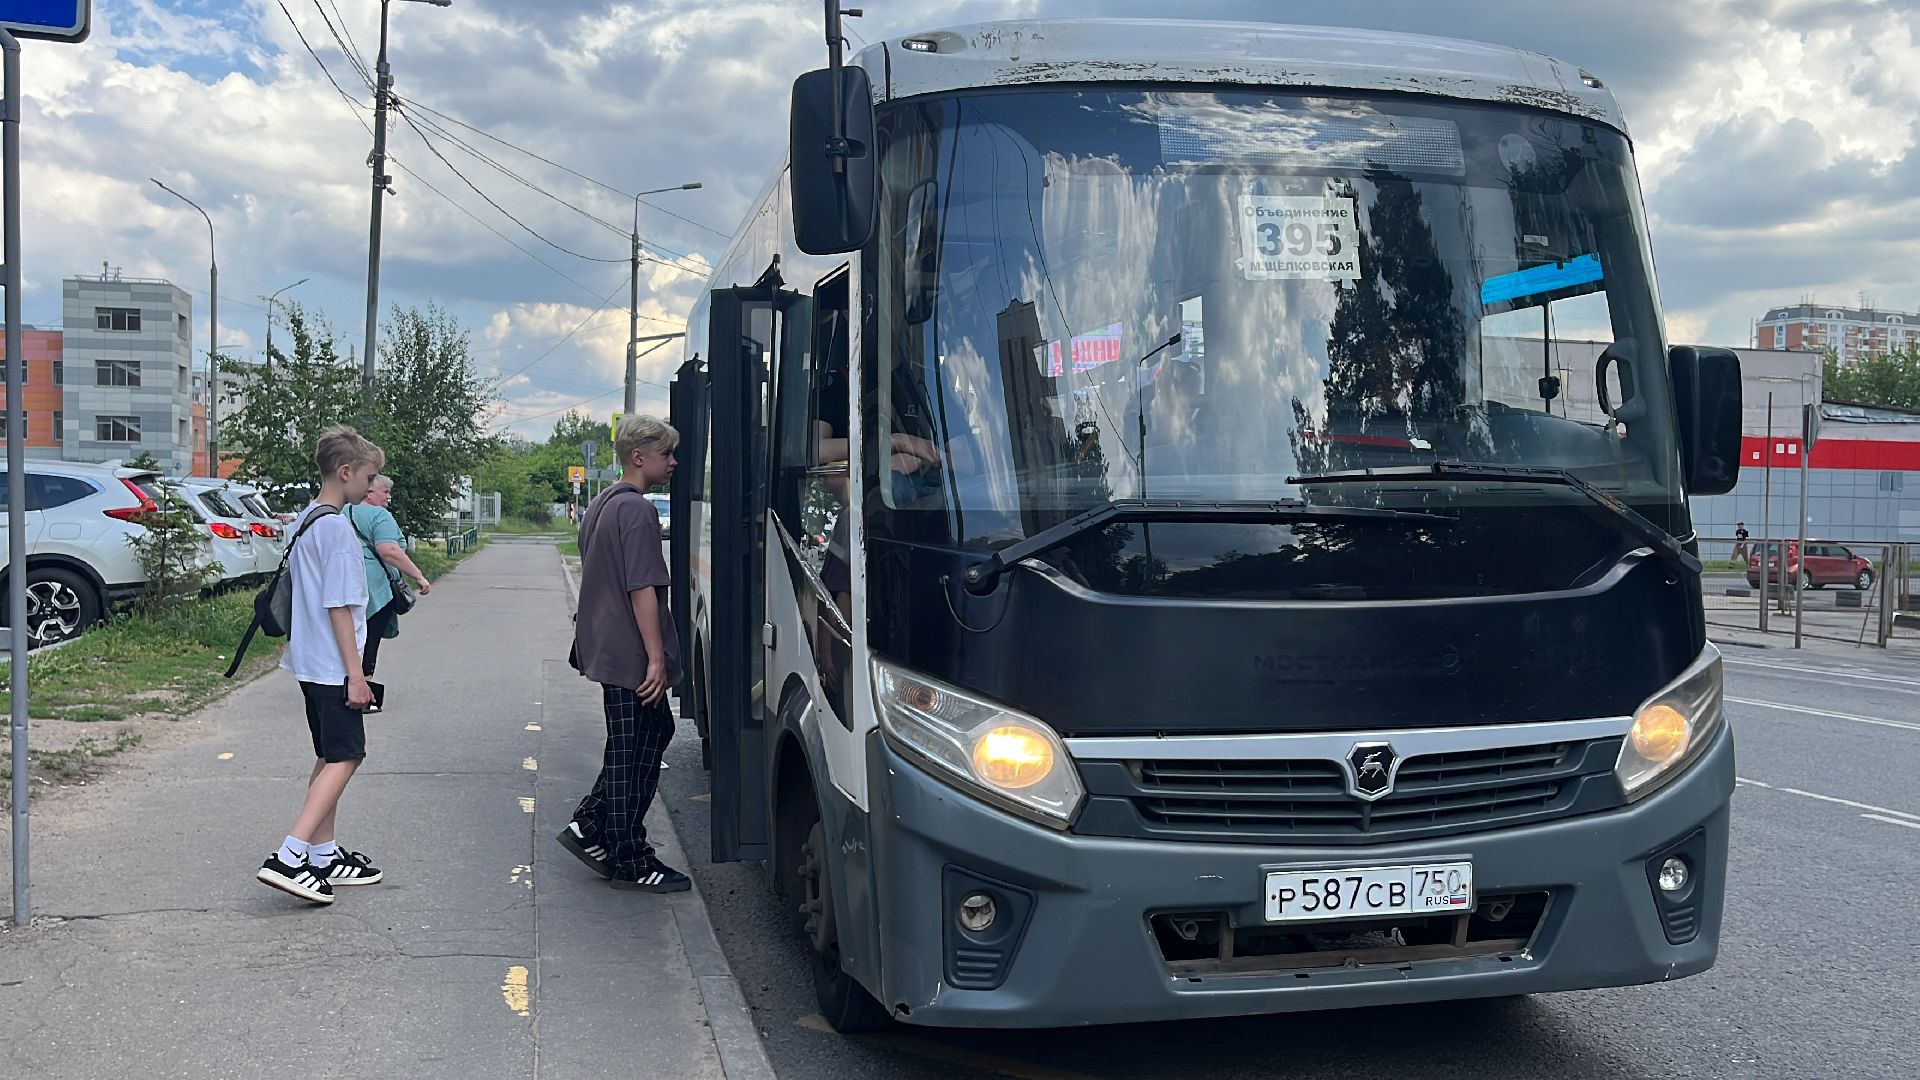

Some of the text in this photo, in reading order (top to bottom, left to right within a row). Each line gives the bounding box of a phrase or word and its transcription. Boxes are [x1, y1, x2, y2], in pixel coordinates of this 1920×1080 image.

[1245, 206, 1348, 219] Объединение
[1257, 222, 1342, 256] 395
[1279, 869, 1462, 914] Р587СВ 750
[1426, 896, 1450, 906] RUS
